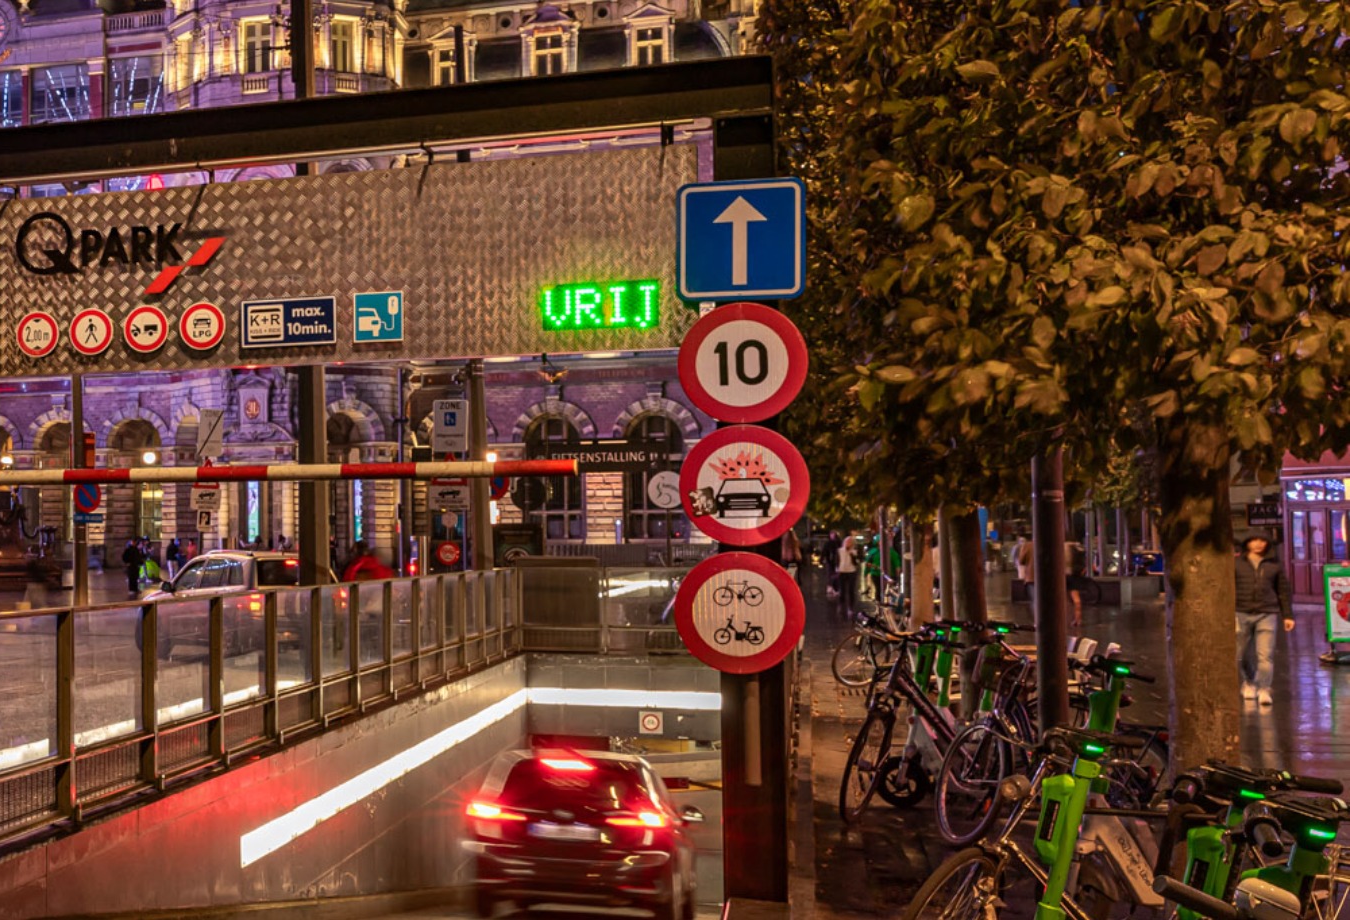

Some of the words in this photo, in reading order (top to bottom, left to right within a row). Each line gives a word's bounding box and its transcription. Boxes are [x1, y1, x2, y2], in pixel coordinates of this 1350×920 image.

[291, 306, 325, 318] max.
[544, 285, 656, 328] VRIJ
[192, 330, 212, 339] LPG
[286, 321, 332, 336] 10min.
[713, 339, 769, 386] 10
[439, 401, 462, 410] ZONE
